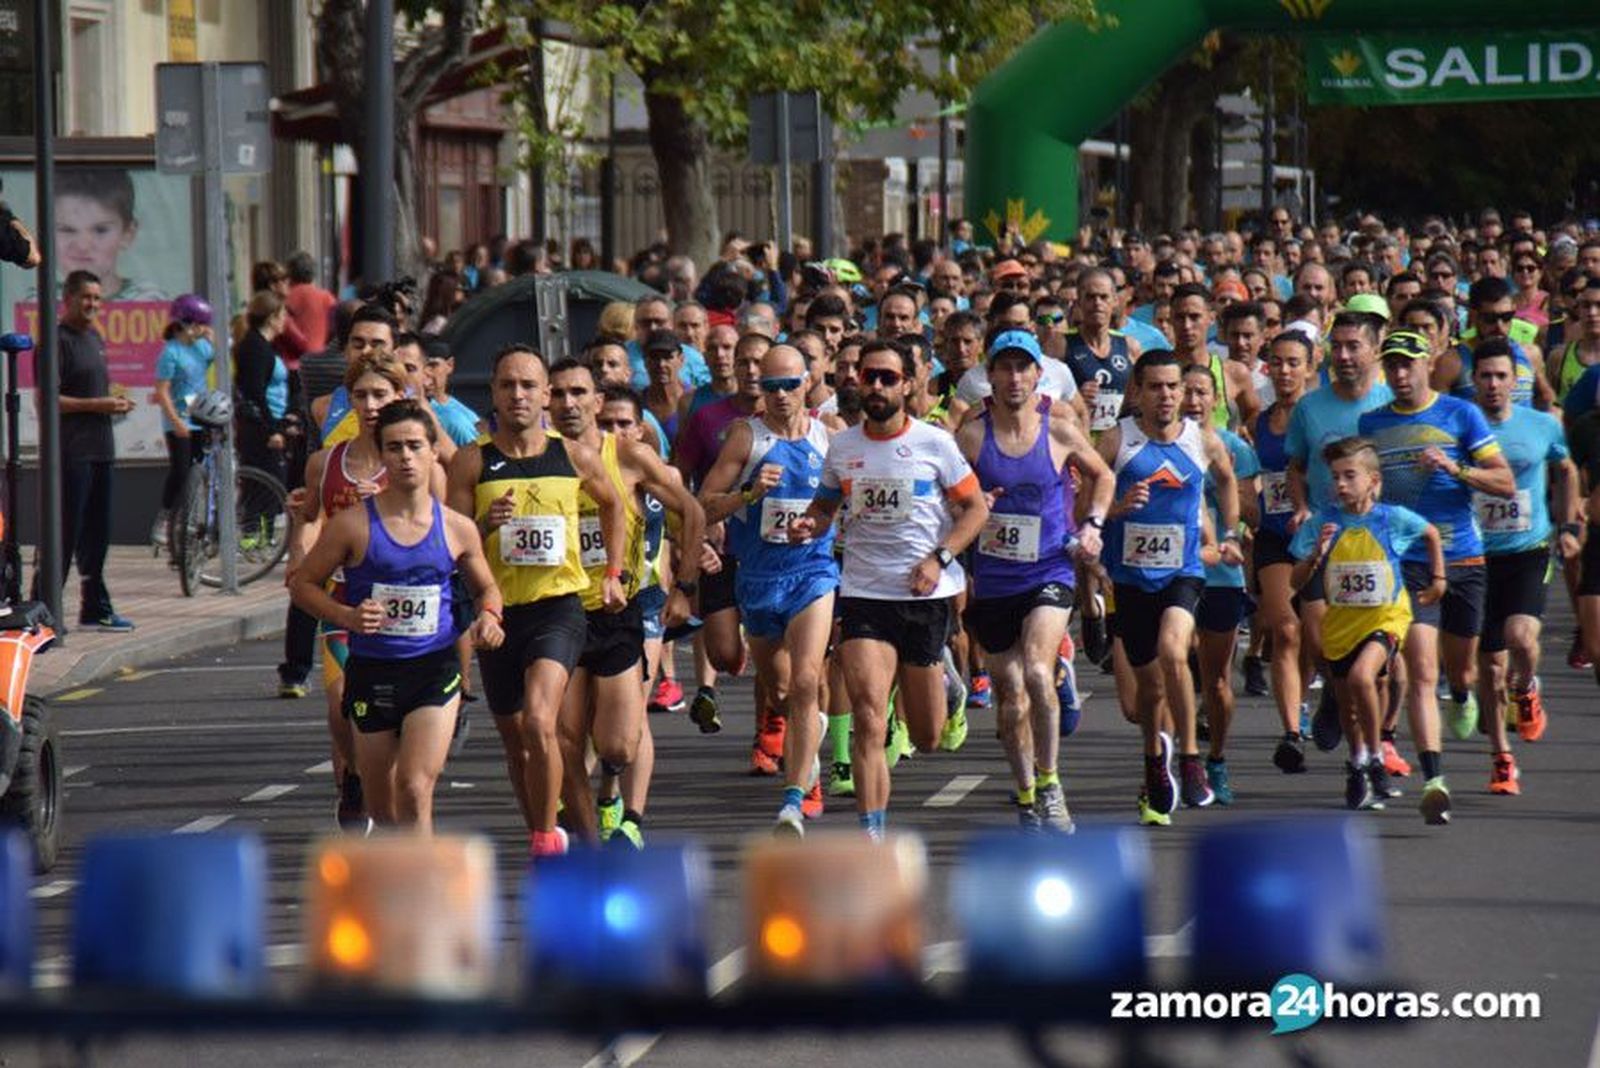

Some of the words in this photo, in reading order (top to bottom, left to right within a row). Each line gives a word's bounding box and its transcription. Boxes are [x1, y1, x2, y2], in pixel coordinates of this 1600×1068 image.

[1385, 41, 1600, 89] SALID
[864, 488, 899, 509] 344
[774, 511, 806, 529] 28
[1483, 501, 1519, 519] 718
[515, 528, 554, 551] 305
[579, 530, 605, 552] 09
[995, 526, 1019, 545] 48
[1135, 535, 1170, 554] 244
[1340, 573, 1376, 592] 435
[386, 598, 426, 620] 394
